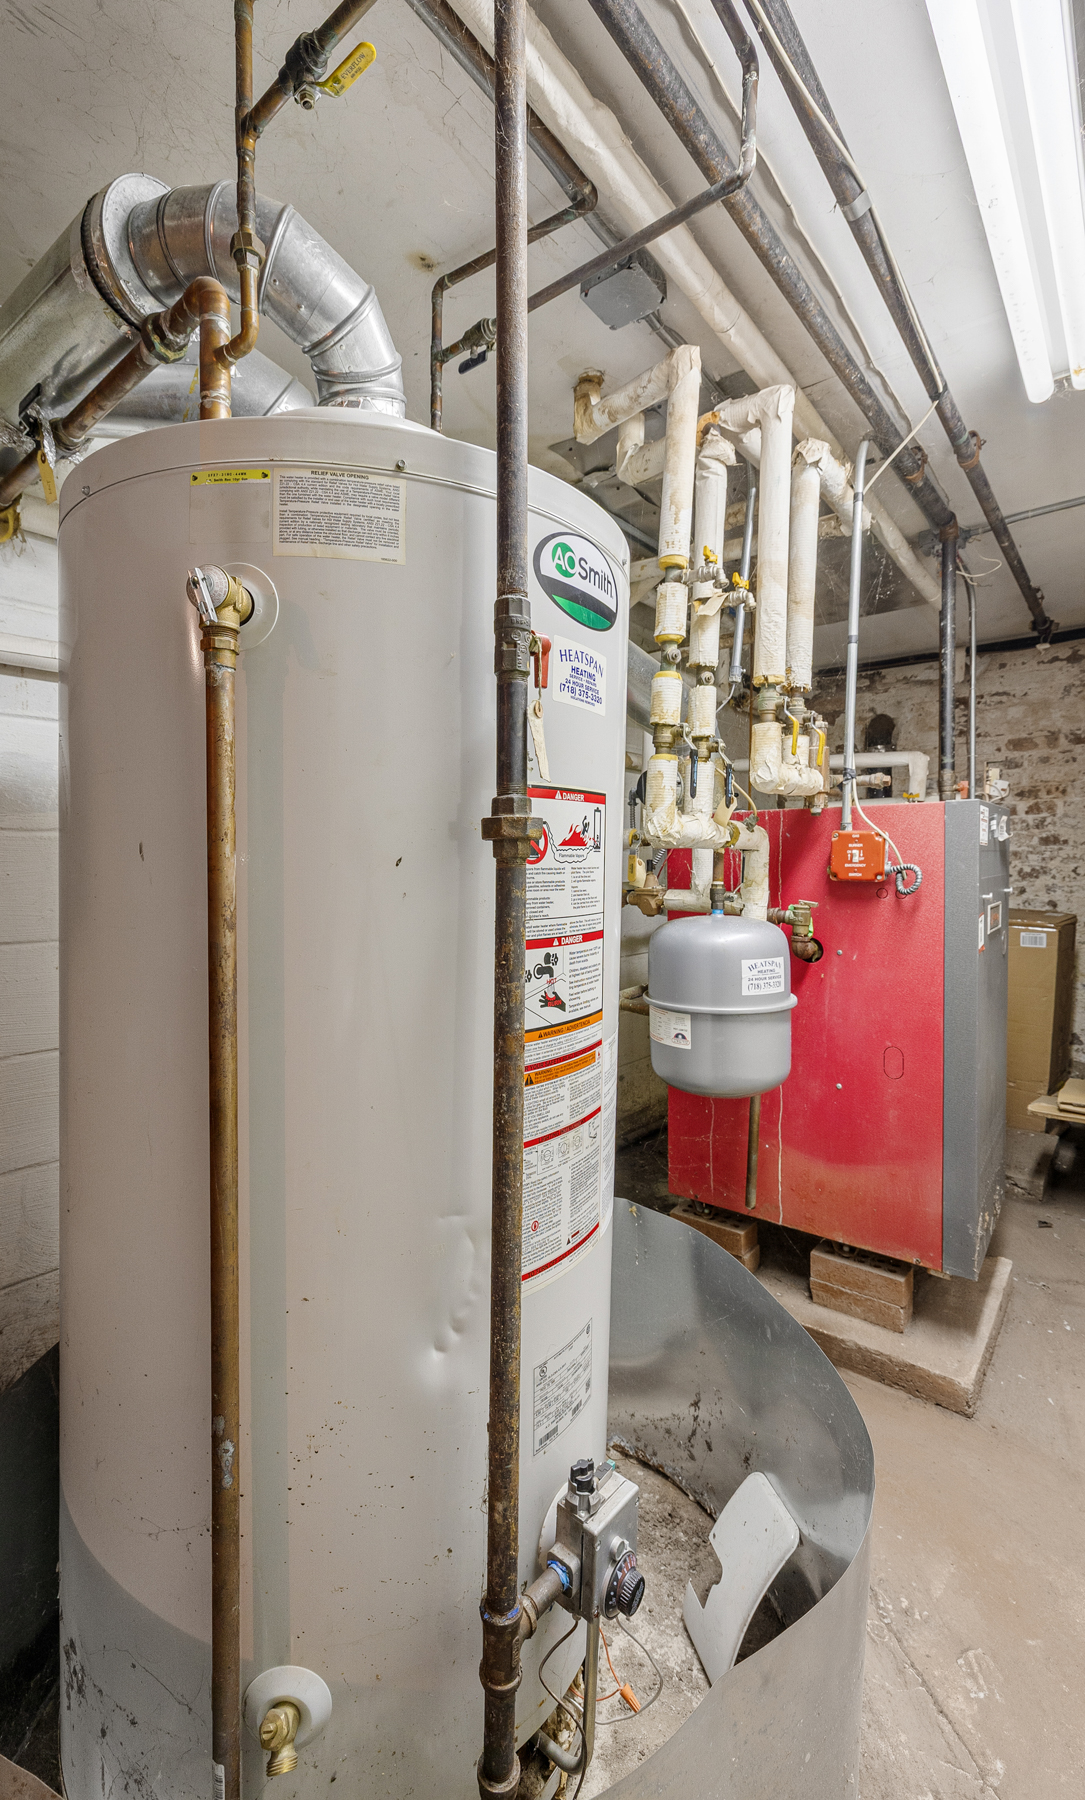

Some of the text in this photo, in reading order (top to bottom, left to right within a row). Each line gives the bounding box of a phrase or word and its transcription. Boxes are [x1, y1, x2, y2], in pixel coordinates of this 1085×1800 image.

[340, 52, 365, 80] EVERFLOW
[552, 542, 613, 599] AO Smith
[559, 649, 604, 678] HEATSPAN
[571, 665, 596, 682] HEATING
[559, 682, 602, 704] (718) 375-3320
[572, 680, 584, 688] HOUR
[585, 684, 599, 695] SERVICE
[563, 792, 584, 802] DANGER
[561, 935, 583, 945] DANGER
[748, 983, 762, 992] (718)
[543, 1028, 564, 1037] WARNING
[545, 1058, 562, 1066] SAFETY
[536, 1264, 548, 1274] TURN
